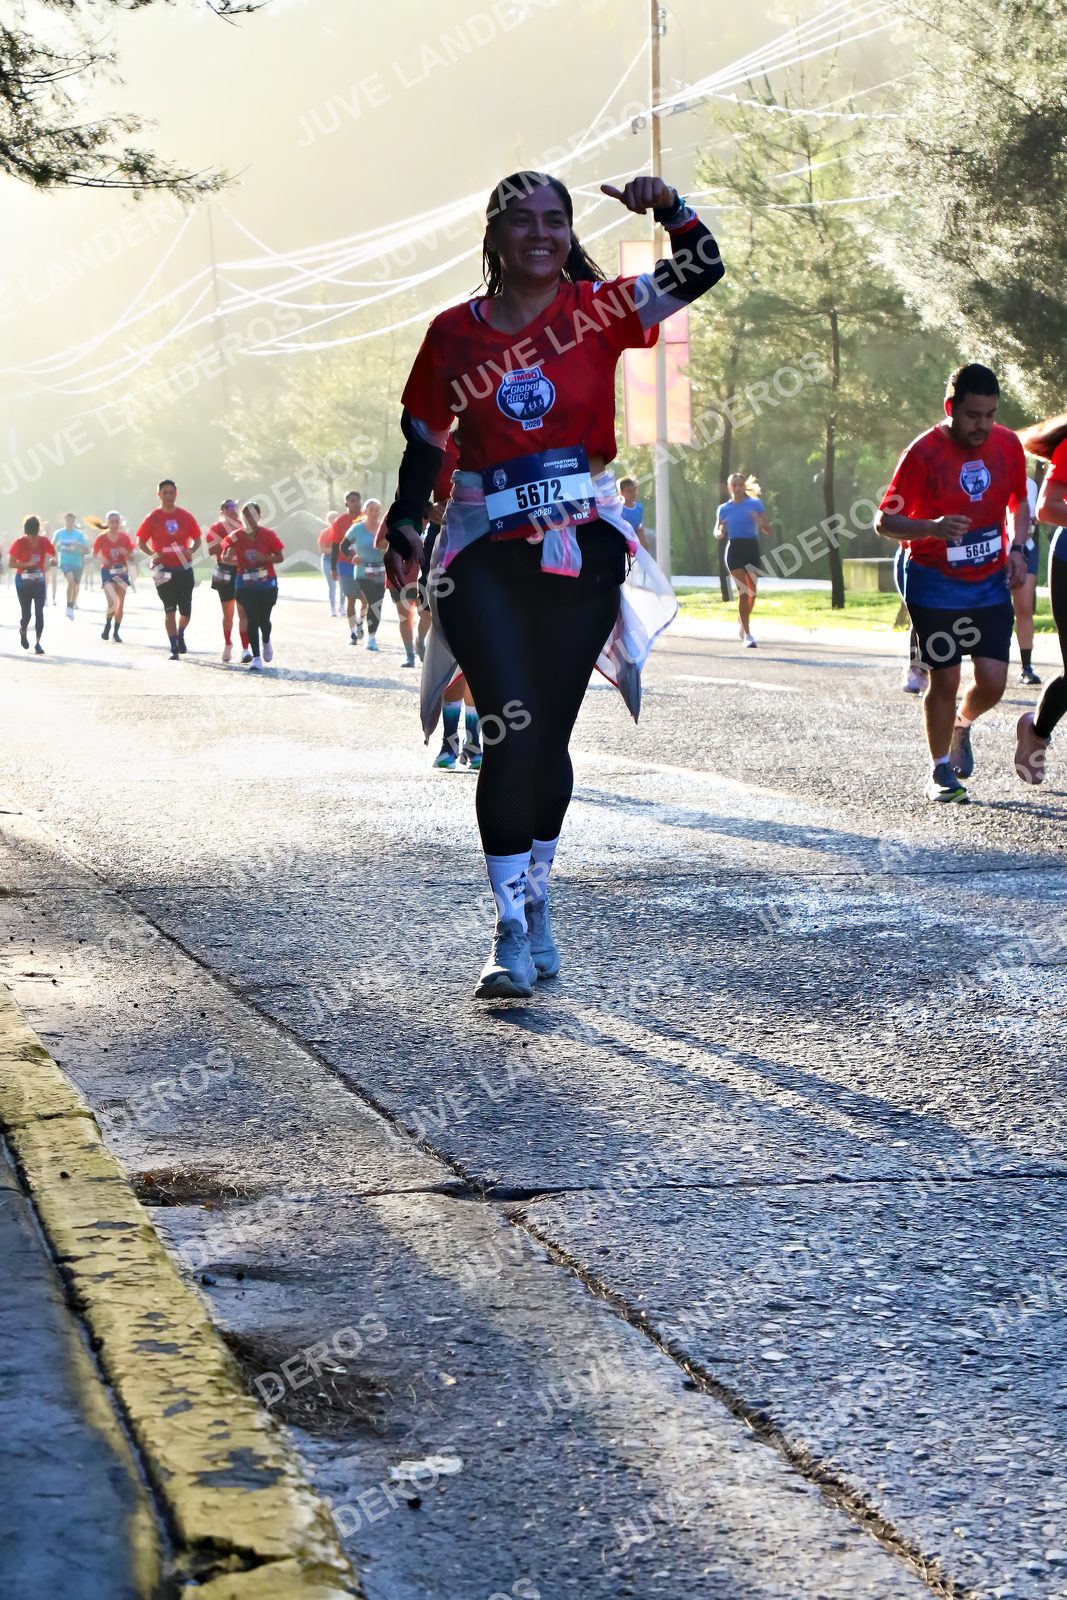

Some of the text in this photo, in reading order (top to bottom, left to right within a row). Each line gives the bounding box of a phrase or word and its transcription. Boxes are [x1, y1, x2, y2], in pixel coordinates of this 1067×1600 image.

[508, 371, 537, 383] BIMBO
[511, 380, 540, 395] Global
[506, 391, 530, 403] Race
[524, 419, 541, 430] 2026
[515, 479, 563, 509] 5672
[965, 542, 991, 558] 5644
